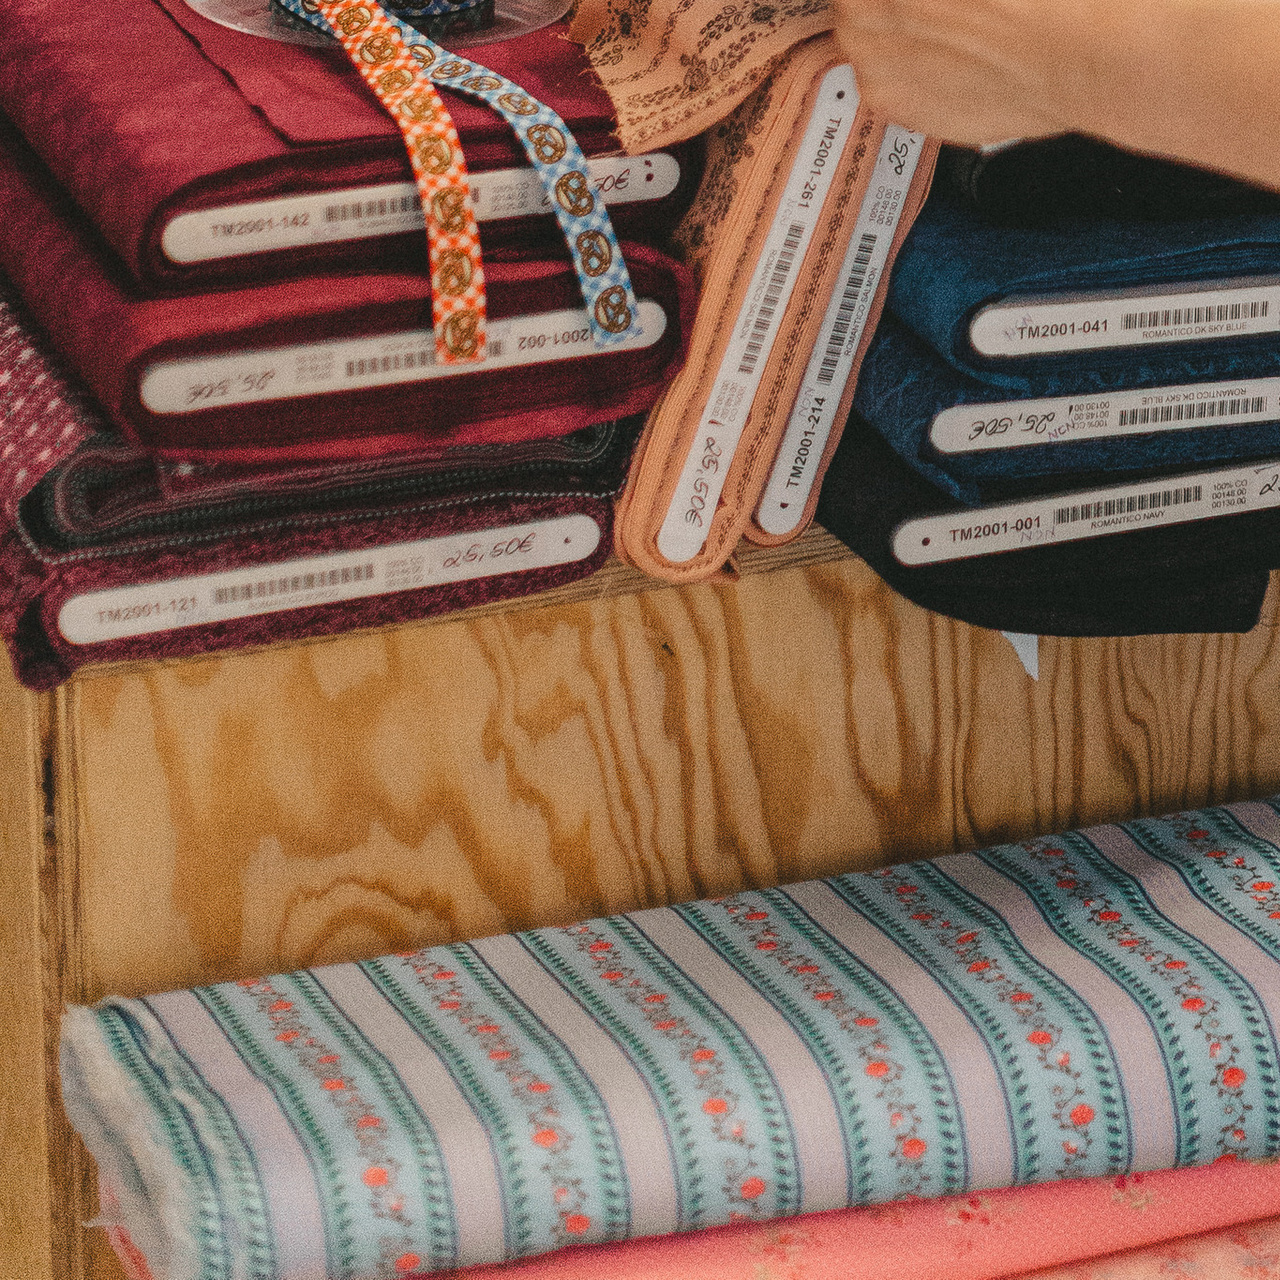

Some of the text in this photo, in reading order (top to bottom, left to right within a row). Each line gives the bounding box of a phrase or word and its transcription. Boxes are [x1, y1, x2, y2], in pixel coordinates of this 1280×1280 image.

[797, 114, 842, 210] TM2001-261
[867, 185, 885, 222] 100% CO
[210, 209, 311, 241] TM2001-142
[738, 248, 777, 340] ROMANTICO SALMON
[843, 266, 878, 357] ROMANTICO SALMON
[517, 325, 593, 352] 2001-002
[1016, 316, 1108, 341] TM2001-041
[1142, 321, 1247, 338] ROMANTICO DK SKY BLUE
[1141, 386, 1246, 405] ROMANTICO DK SKY BLUE
[966, 409, 1057, 442] 25,50€
[1087, 419, 1107, 428] 100%
[785, 394, 827, 491] TM2001-214
[679, 436, 730, 527] 25,50€
[1212, 479, 1248, 491] 100% CO
[948, 513, 1042, 543] TM2001-001
[1089, 509, 1166, 529] ROMANTICO NAVY
[439, 532, 538, 568] 25,50€
[96, 594, 198, 626] TM2001-121
